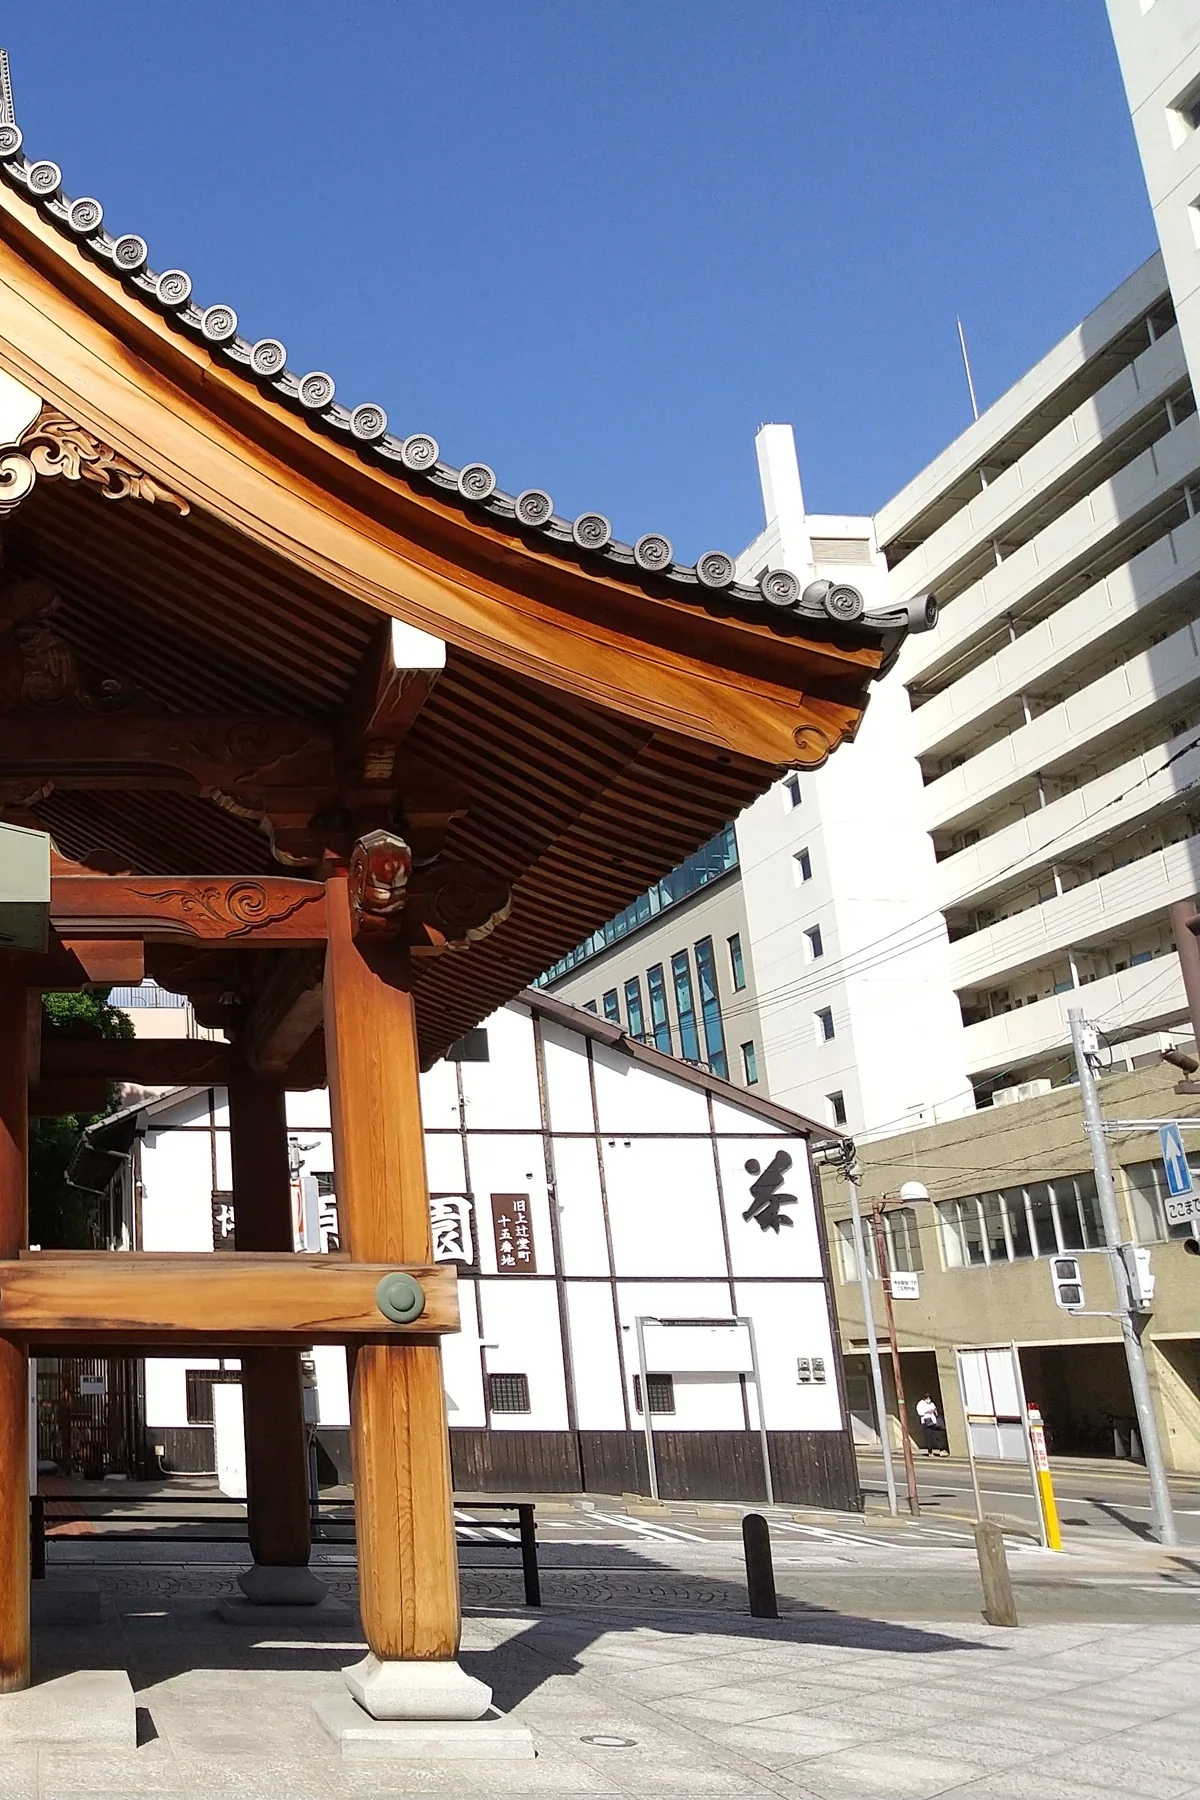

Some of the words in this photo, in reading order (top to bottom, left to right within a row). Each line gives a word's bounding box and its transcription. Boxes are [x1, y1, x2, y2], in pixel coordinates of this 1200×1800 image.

[742, 1149, 798, 1235] 茶
[1168, 1198, 1200, 1219] ここまで
[497, 1214, 516, 1267] 十五番地
[513, 1199, 532, 1263] 旧上辻堂町
